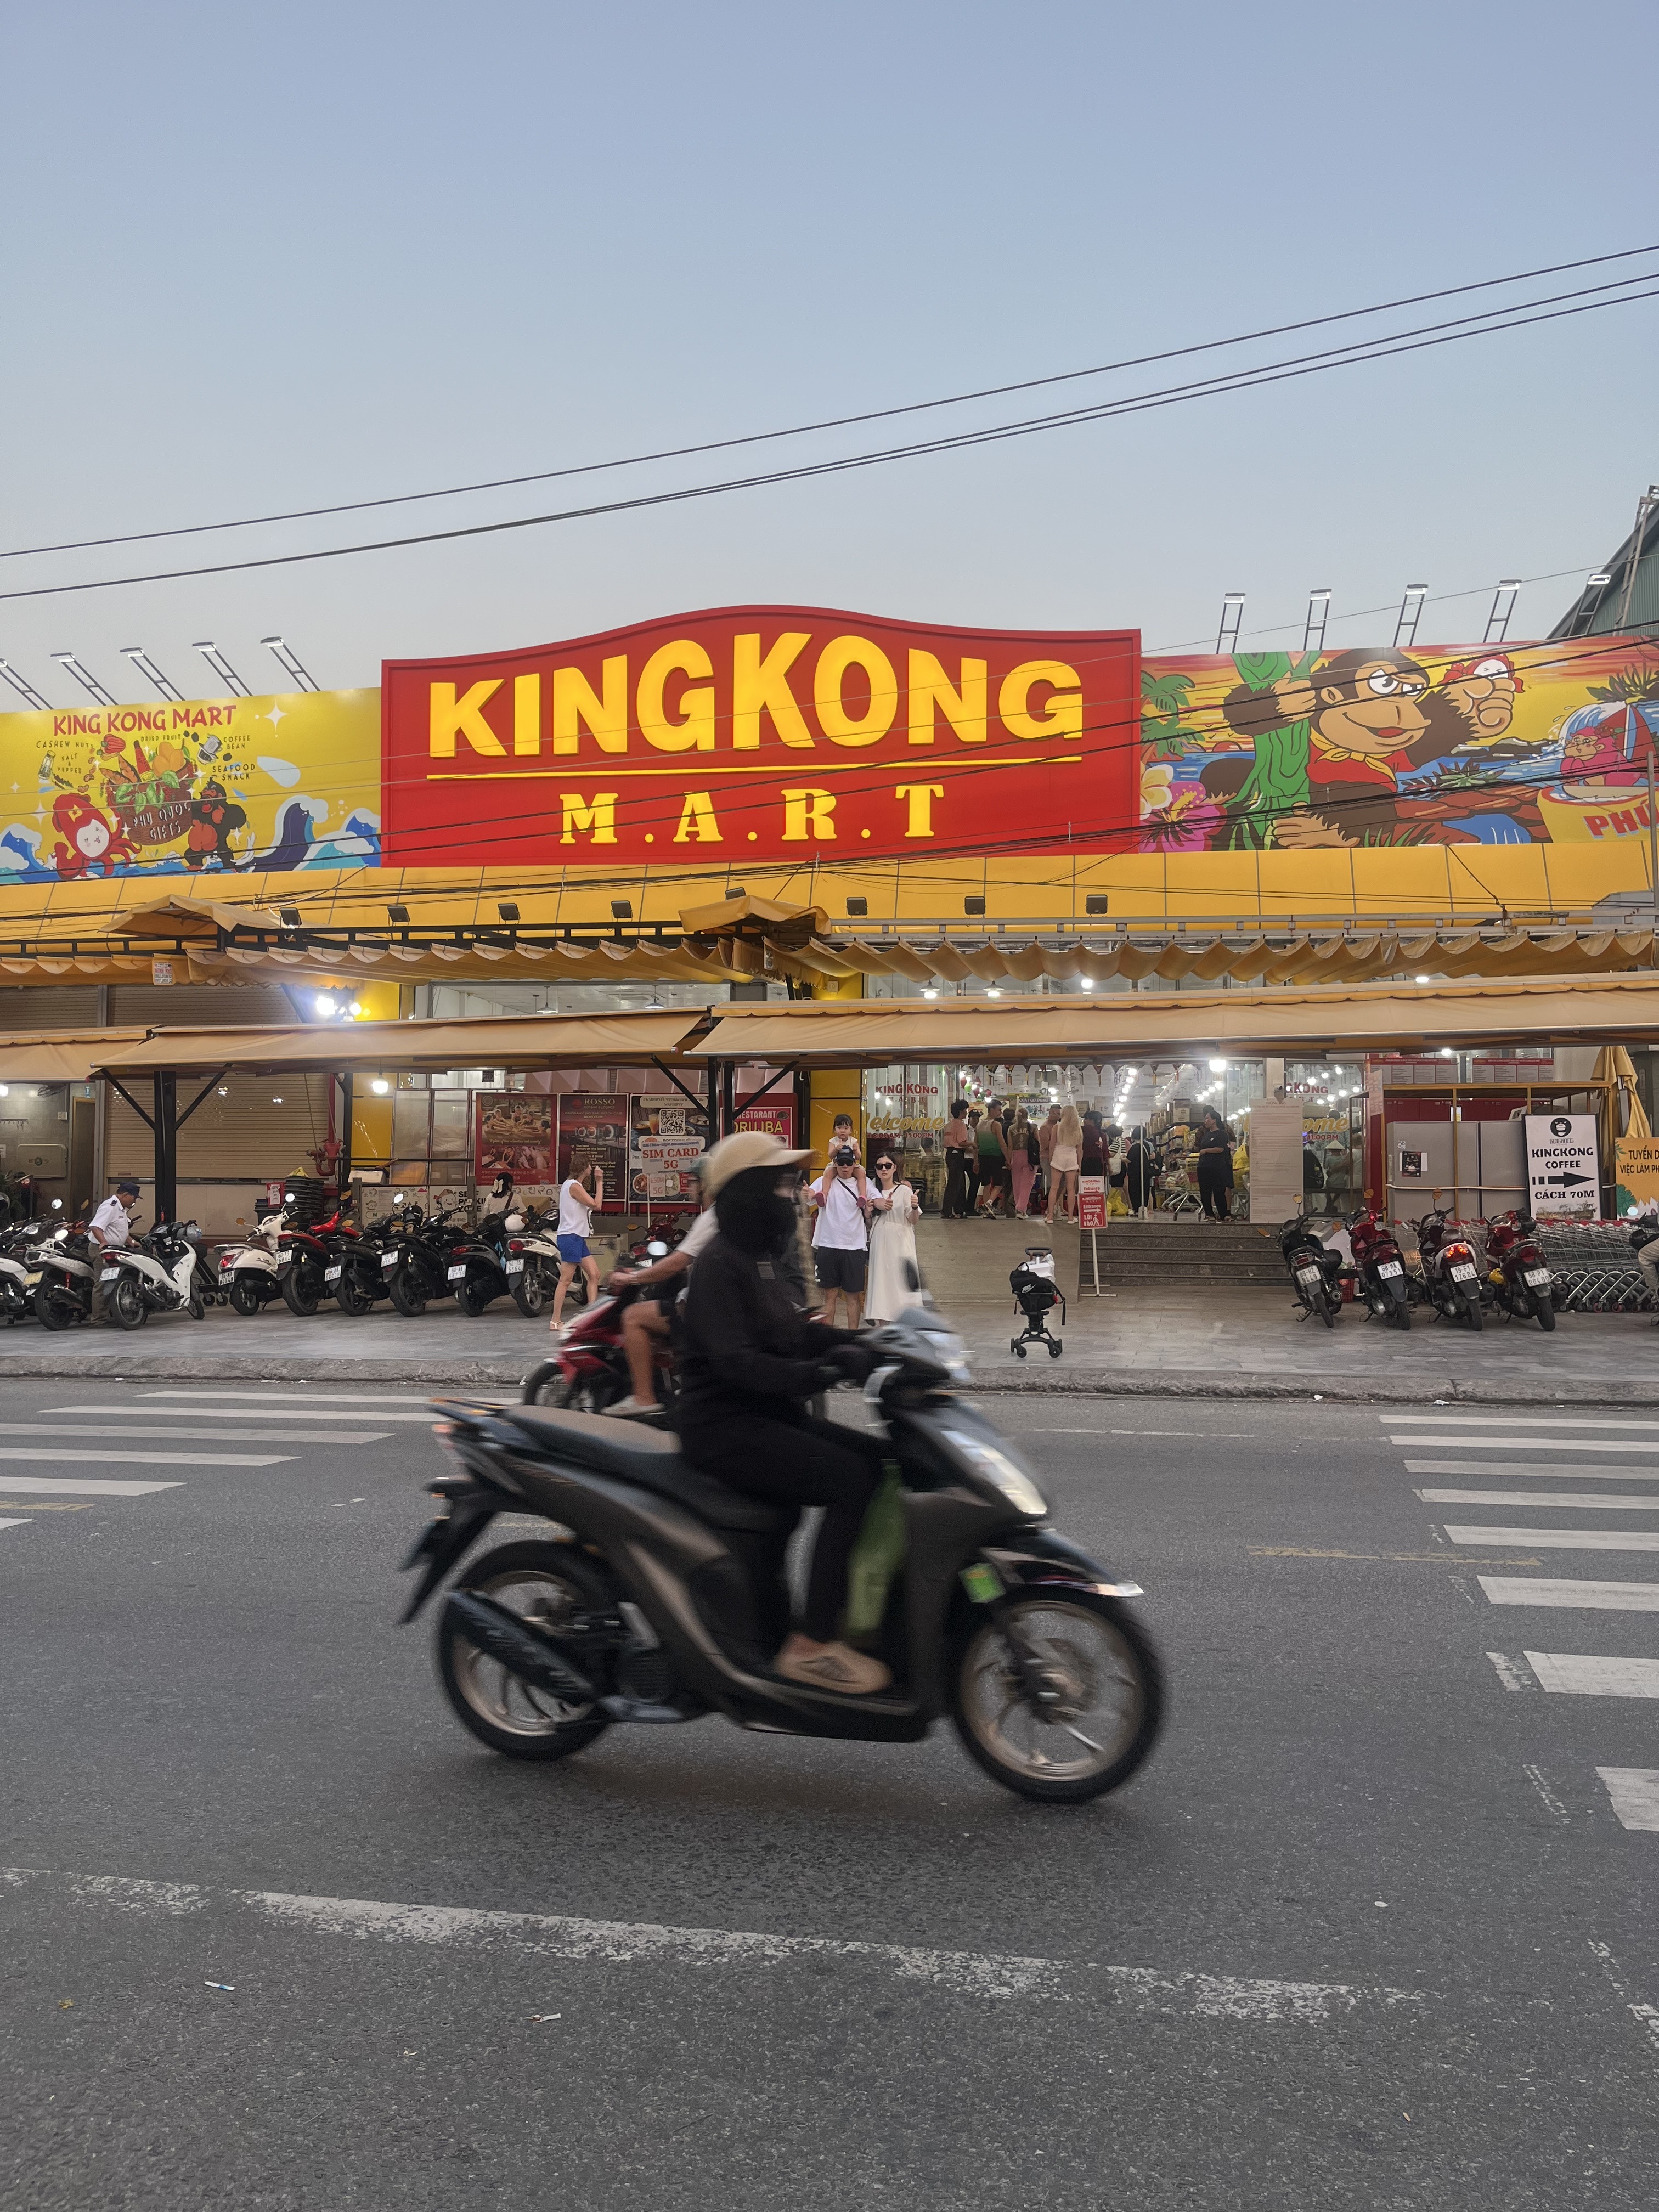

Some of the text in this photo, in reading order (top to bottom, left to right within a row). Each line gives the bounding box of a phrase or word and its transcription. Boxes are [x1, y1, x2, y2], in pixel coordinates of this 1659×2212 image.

[429, 631, 1084, 758] KINGKONG
[54, 704, 237, 736] KING KONG MART
[223, 735, 251, 743] COFFEE
[36, 740, 70, 749] CASHEW
[61, 753, 78, 761] SALT
[212, 763, 255, 773] SEAFOOD
[222, 773, 250, 781] SNACK
[149, 820, 181, 840] GIFTS
[876, 1083, 938, 1094] KING KONG
[642, 1149, 664, 1159] SIM
[667, 1148, 699, 1158] CARD
[1532, 1147, 1593, 1158] KINGKONG
[663, 1160, 679, 1169] 5G
[1545, 1160, 1581, 1169] COFFEE
[1620, 1163, 1635, 1176] VIỆC
[1636, 1163, 1650, 1173] LÀM
[1534, 1189, 1595, 1199] CÁCH 70M
